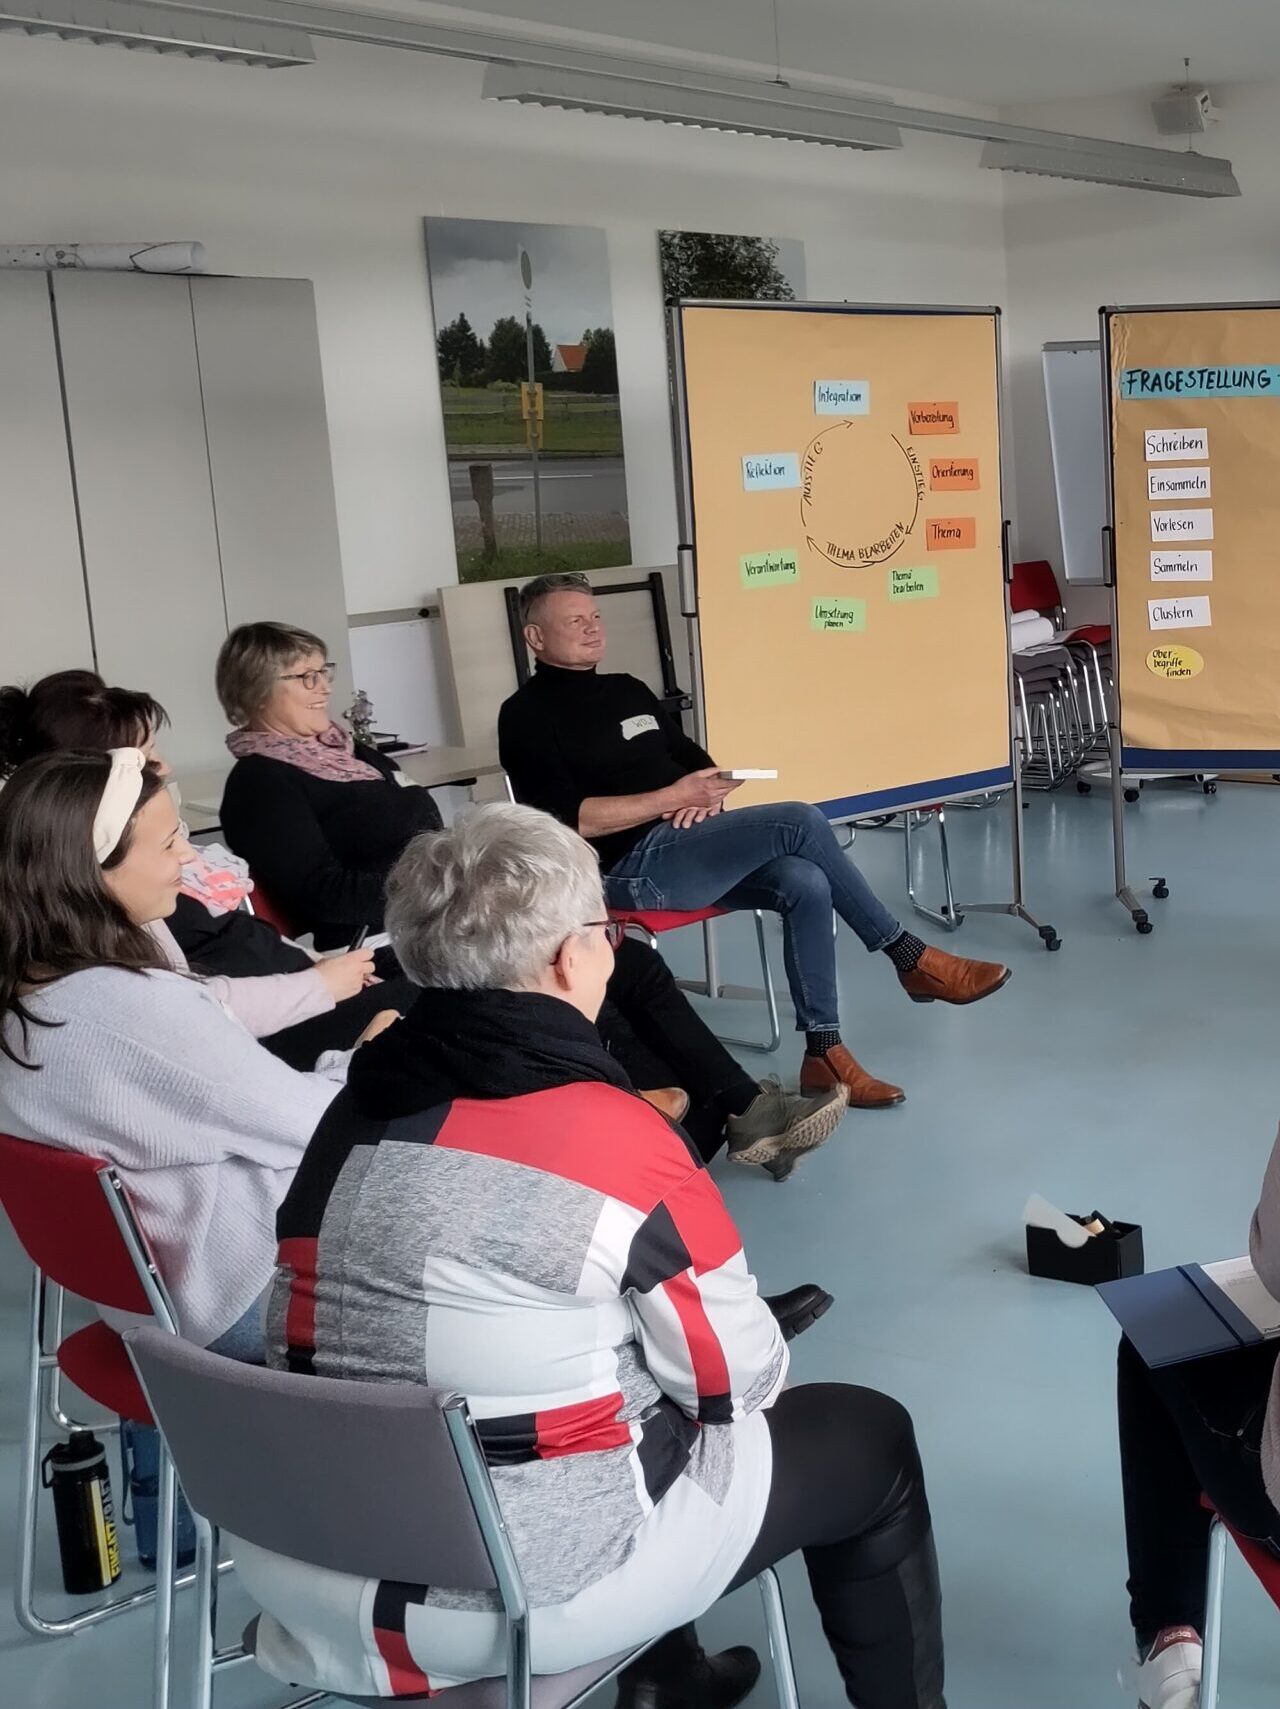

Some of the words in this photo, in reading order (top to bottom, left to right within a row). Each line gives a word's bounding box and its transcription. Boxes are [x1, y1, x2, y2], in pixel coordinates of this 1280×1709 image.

[1126, 369, 1272, 395] FRAGESTELLUNG
[818, 386, 862, 405] Integration
[1147, 436, 1203, 455] Schreiben
[1150, 476, 1207, 494] Einsammeln
[930, 523, 961, 540] Thema
[1153, 517, 1194, 532] Vorlesen
[826, 541, 856, 561] THEMA
[858, 521, 904, 559] BEARBEITEN
[1153, 557, 1198, 574] Sammeln
[1152, 605, 1194, 622] Clustern
